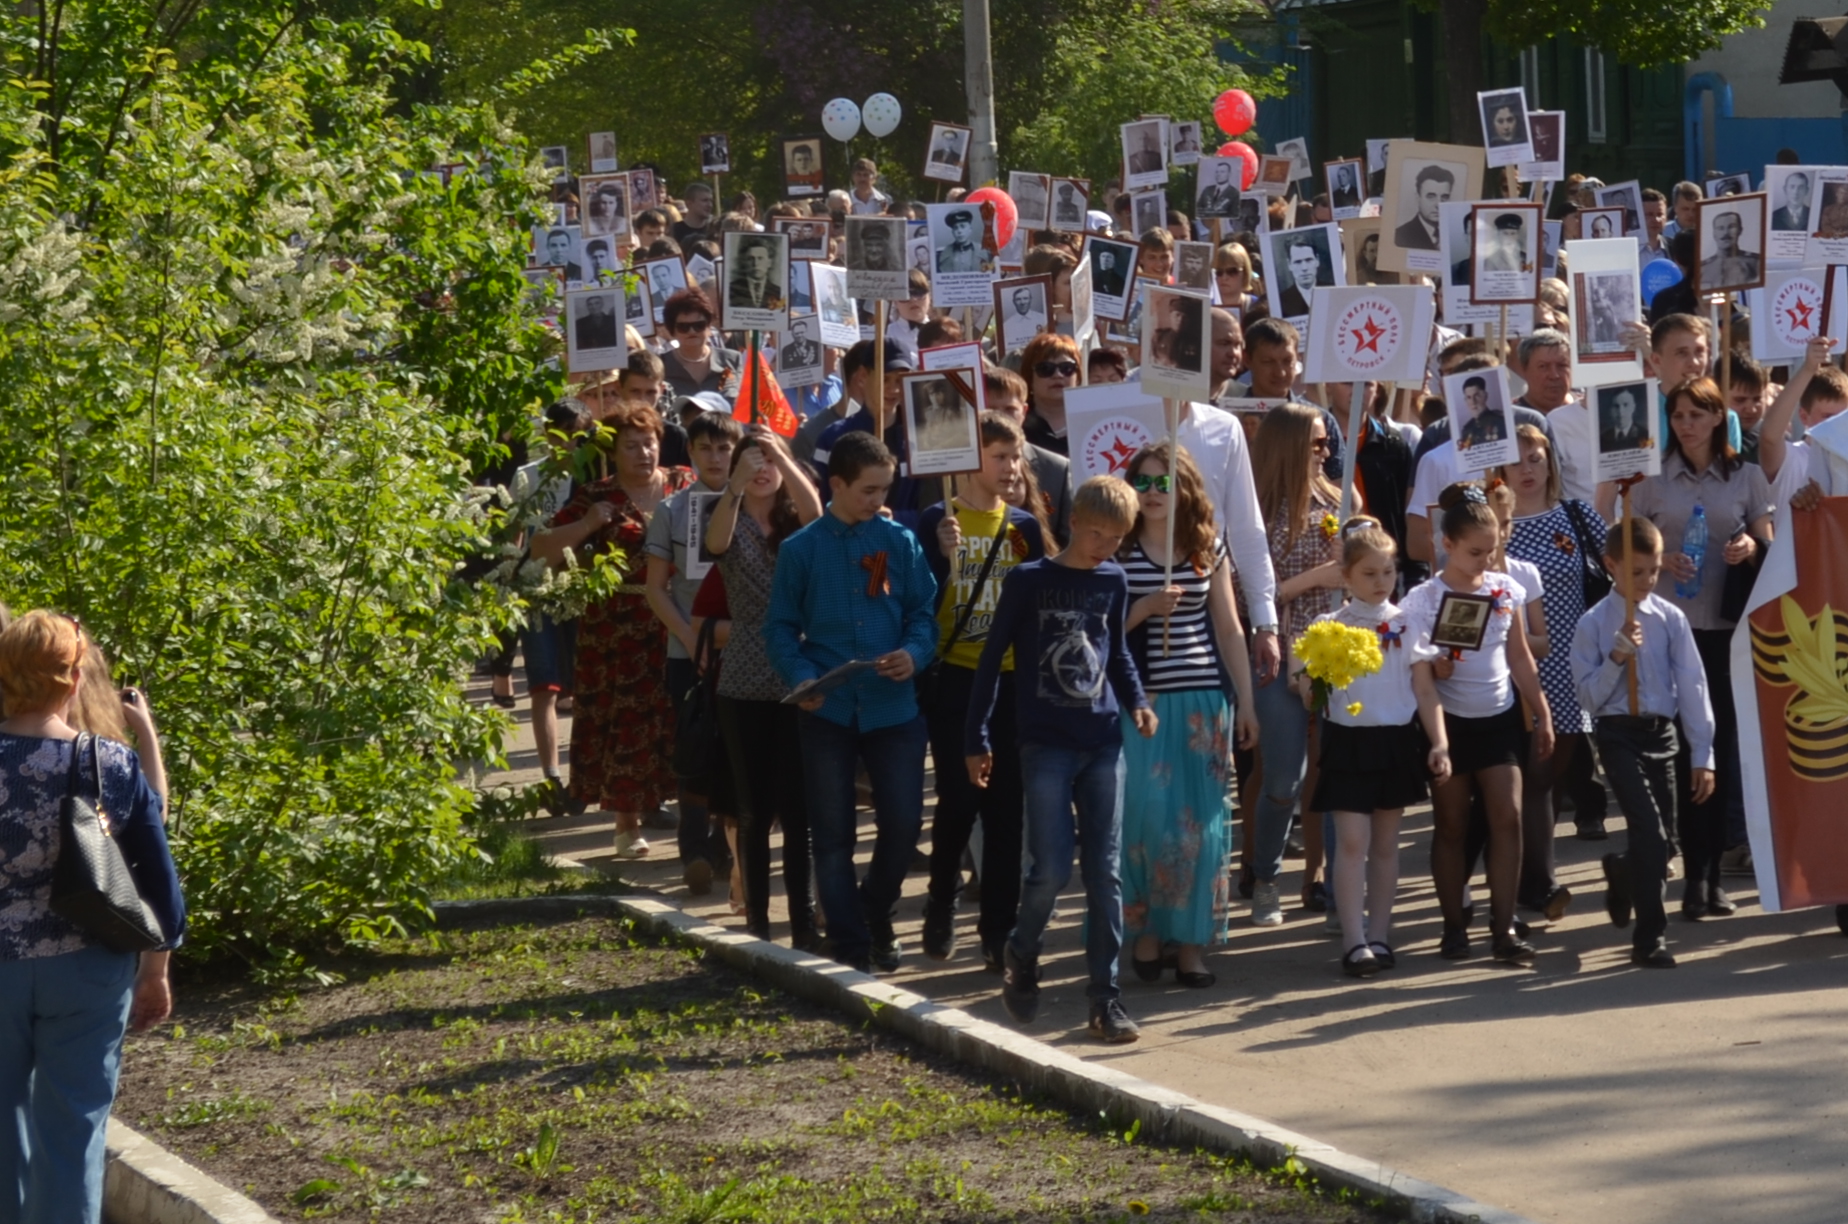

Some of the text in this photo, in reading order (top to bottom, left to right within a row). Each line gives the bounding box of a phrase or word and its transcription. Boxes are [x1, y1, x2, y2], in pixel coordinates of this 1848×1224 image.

[1337, 301, 1398, 346] БЕССМЕРТНЫЙ ПОЛК
[1346, 355, 1385, 369] ПЕТРОВСК
[1085, 421, 1139, 470] БЕССМЕРТНЫЙ
[689, 495, 698, 549] 1941-1945
